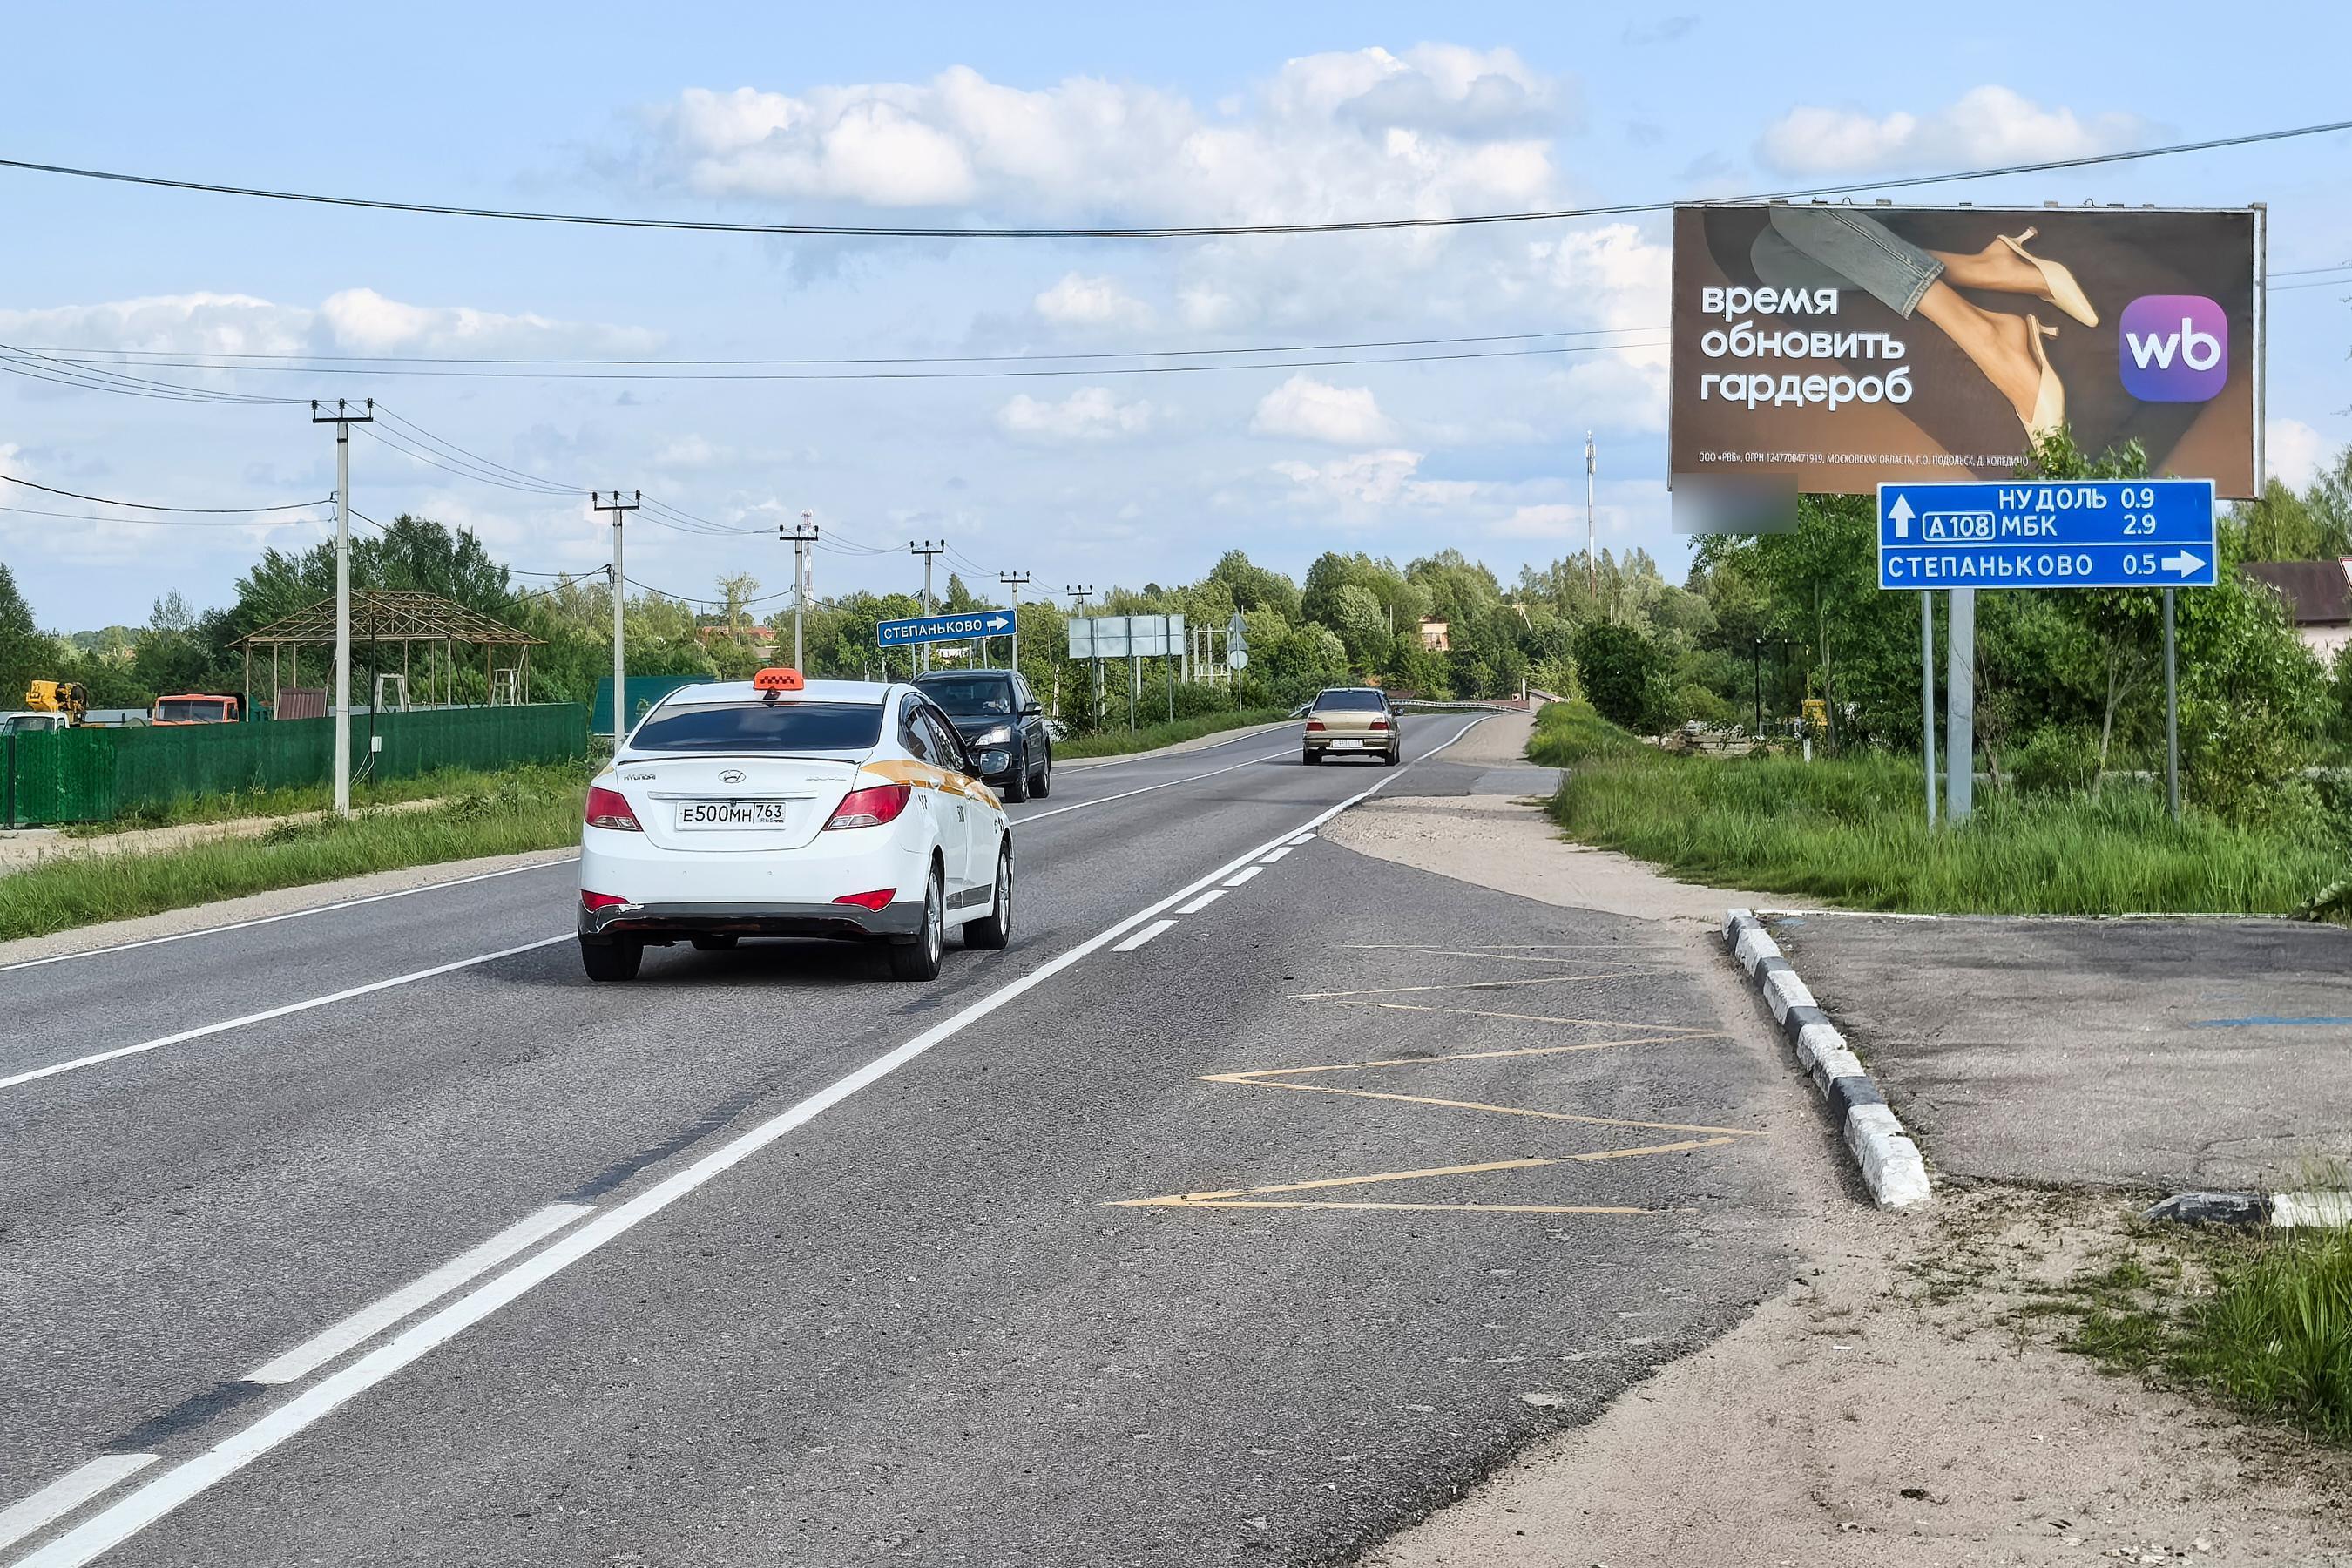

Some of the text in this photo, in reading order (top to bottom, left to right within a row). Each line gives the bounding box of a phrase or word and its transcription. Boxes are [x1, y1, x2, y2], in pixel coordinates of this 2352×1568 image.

[1701, 287, 1839, 322] время
[1700, 320, 1906, 360] обновить
[2126, 317, 2220, 371] wb
[1700, 365, 1914, 412] гардероб
[1699, 452, 1716, 463] ООО
[1745, 452, 1765, 463] ОГРН
[1827, 454, 1877, 465] МОСКОВСКАЯ
[1879, 455, 1915, 466] ОБЛАСТЬ,
[1998, 487, 2155, 513] НУДОЛЬ 0.9
[2001, 516, 2058, 537] МБК
[2123, 515, 2156, 535] 2.9
[1888, 554, 2157, 578] СТЕПАНЬКОВО 0.5
[883, 619, 983, 639] СТЕПАНЬКОВО
[755, 804, 782, 818] 763
